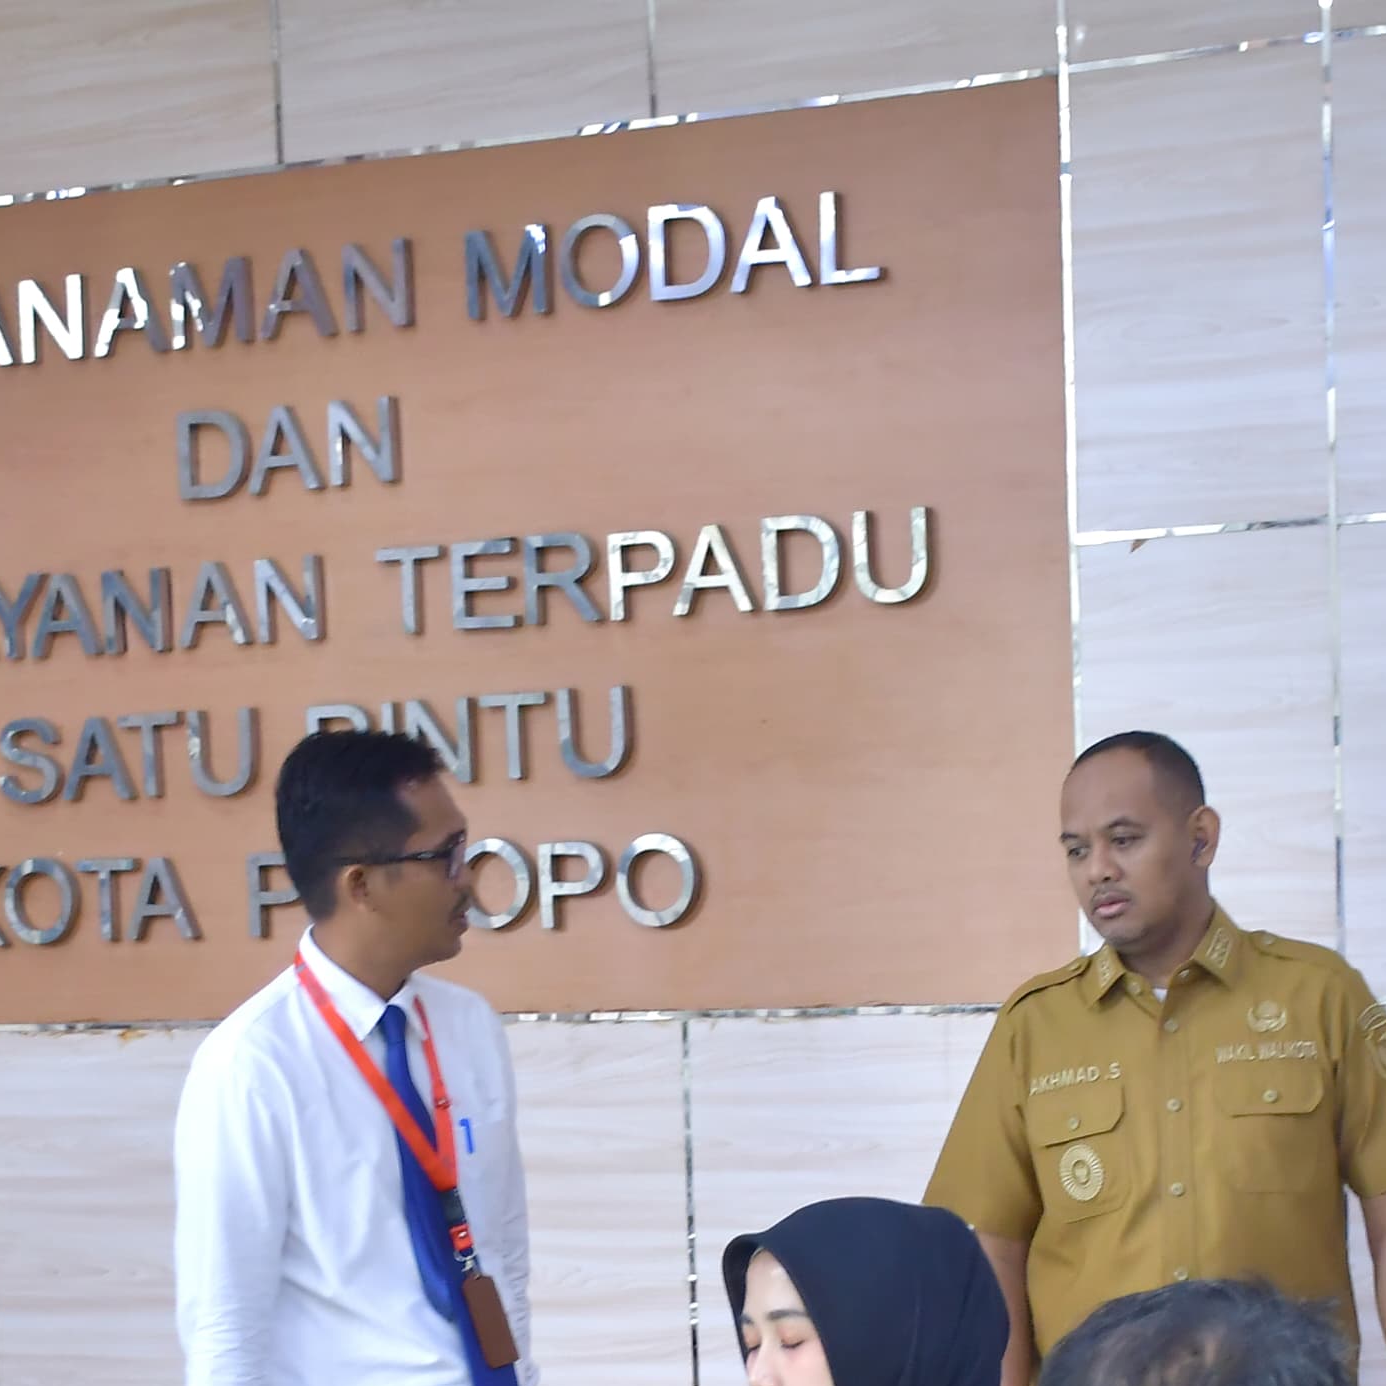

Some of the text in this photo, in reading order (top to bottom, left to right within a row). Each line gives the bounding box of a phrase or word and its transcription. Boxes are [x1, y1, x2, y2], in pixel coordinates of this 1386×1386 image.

[464, 190, 888, 322] MODAL
[176, 395, 401, 502] DAN
[375, 505, 932, 636] TERPADU
[305, 684, 634, 784] NTU
[246, 832, 702, 939] POPO
[1030, 1065, 1100, 1096] AKHMAD
